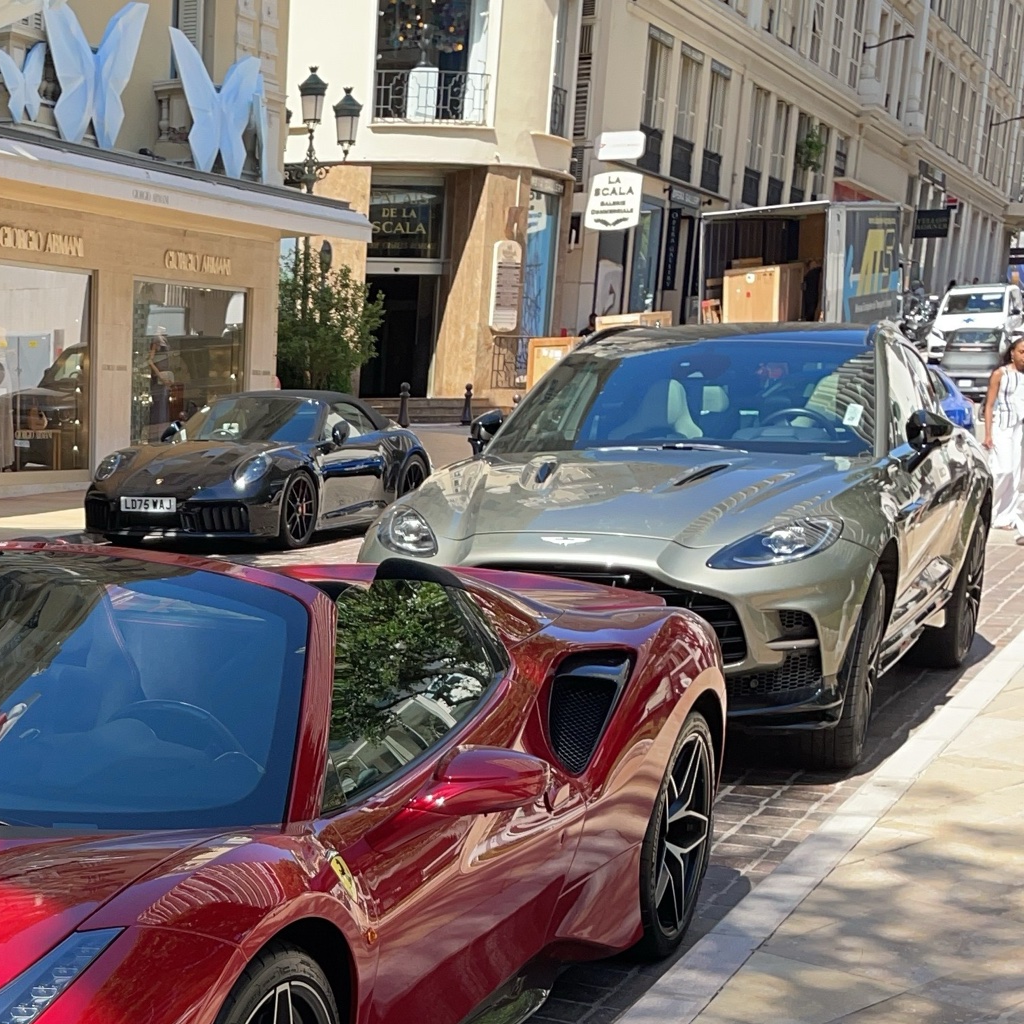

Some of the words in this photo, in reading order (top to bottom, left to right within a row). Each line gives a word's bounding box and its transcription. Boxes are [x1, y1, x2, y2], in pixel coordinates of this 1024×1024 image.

[608, 176, 621, 185] LA
[594, 186, 634, 197] SCALA
[381, 207, 398, 218] DE
[402, 208, 417, 218] LA
[372, 221, 427, 235] SCALA
[44, 232, 85, 258] ARMANI
[164, 250, 198, 273] GIORGIO
[200, 255, 231, 277] ARMANI
[124, 498, 150, 510] LD75
